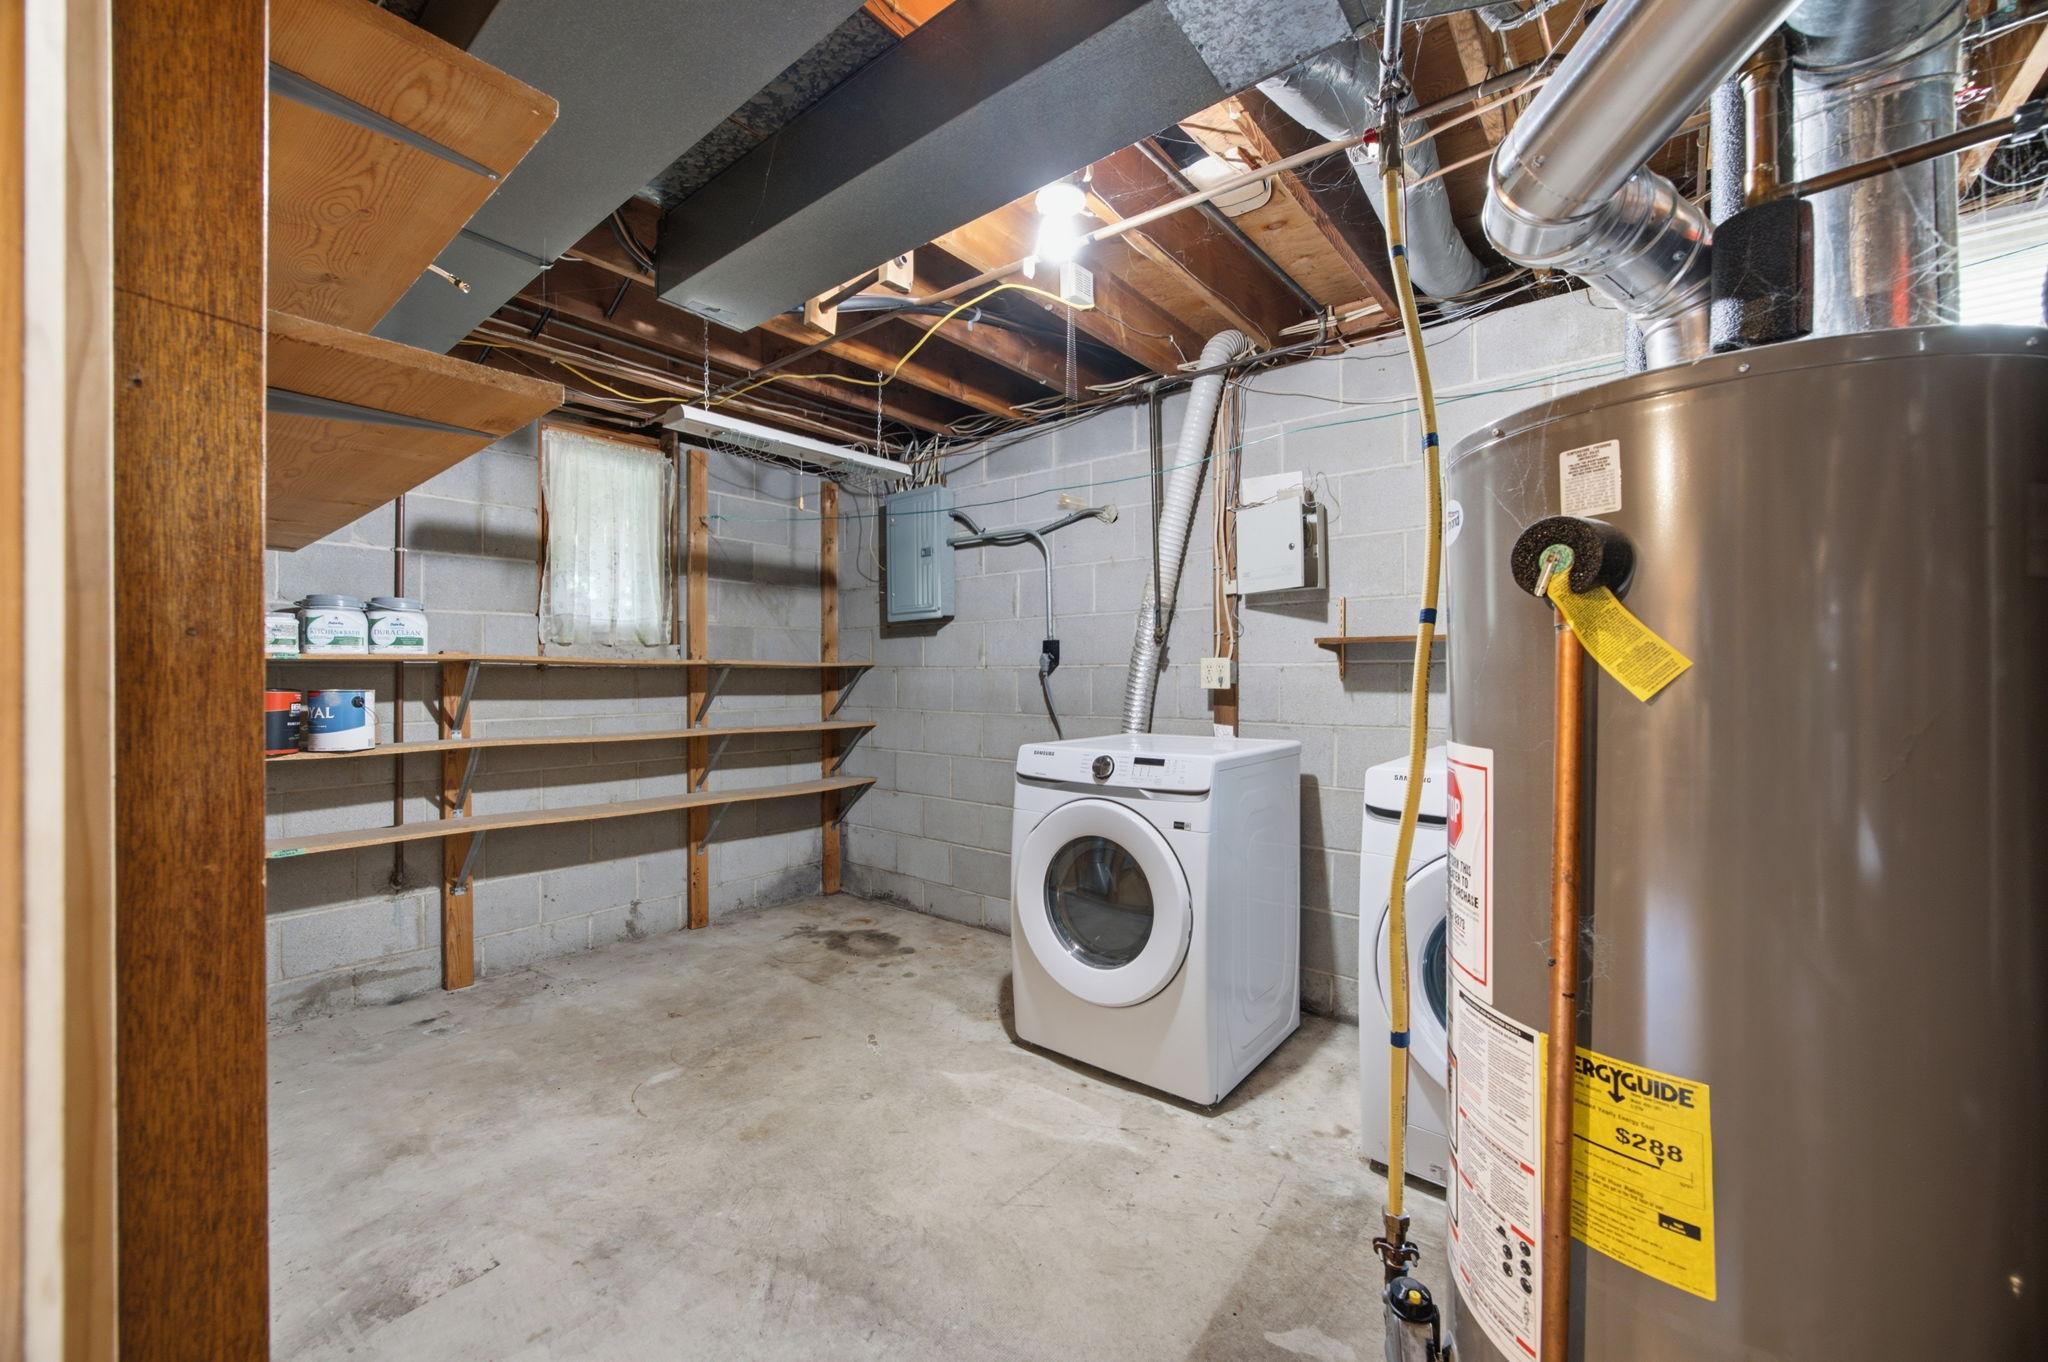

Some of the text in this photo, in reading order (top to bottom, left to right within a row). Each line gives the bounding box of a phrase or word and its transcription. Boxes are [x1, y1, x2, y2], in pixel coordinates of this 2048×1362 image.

[307, 706, 335, 719] YAL
[1452, 882, 1479, 909] PURCHASE
[1575, 1055, 1695, 1108] ERGYGUIDE
[1615, 1127, 1684, 1163] $288
